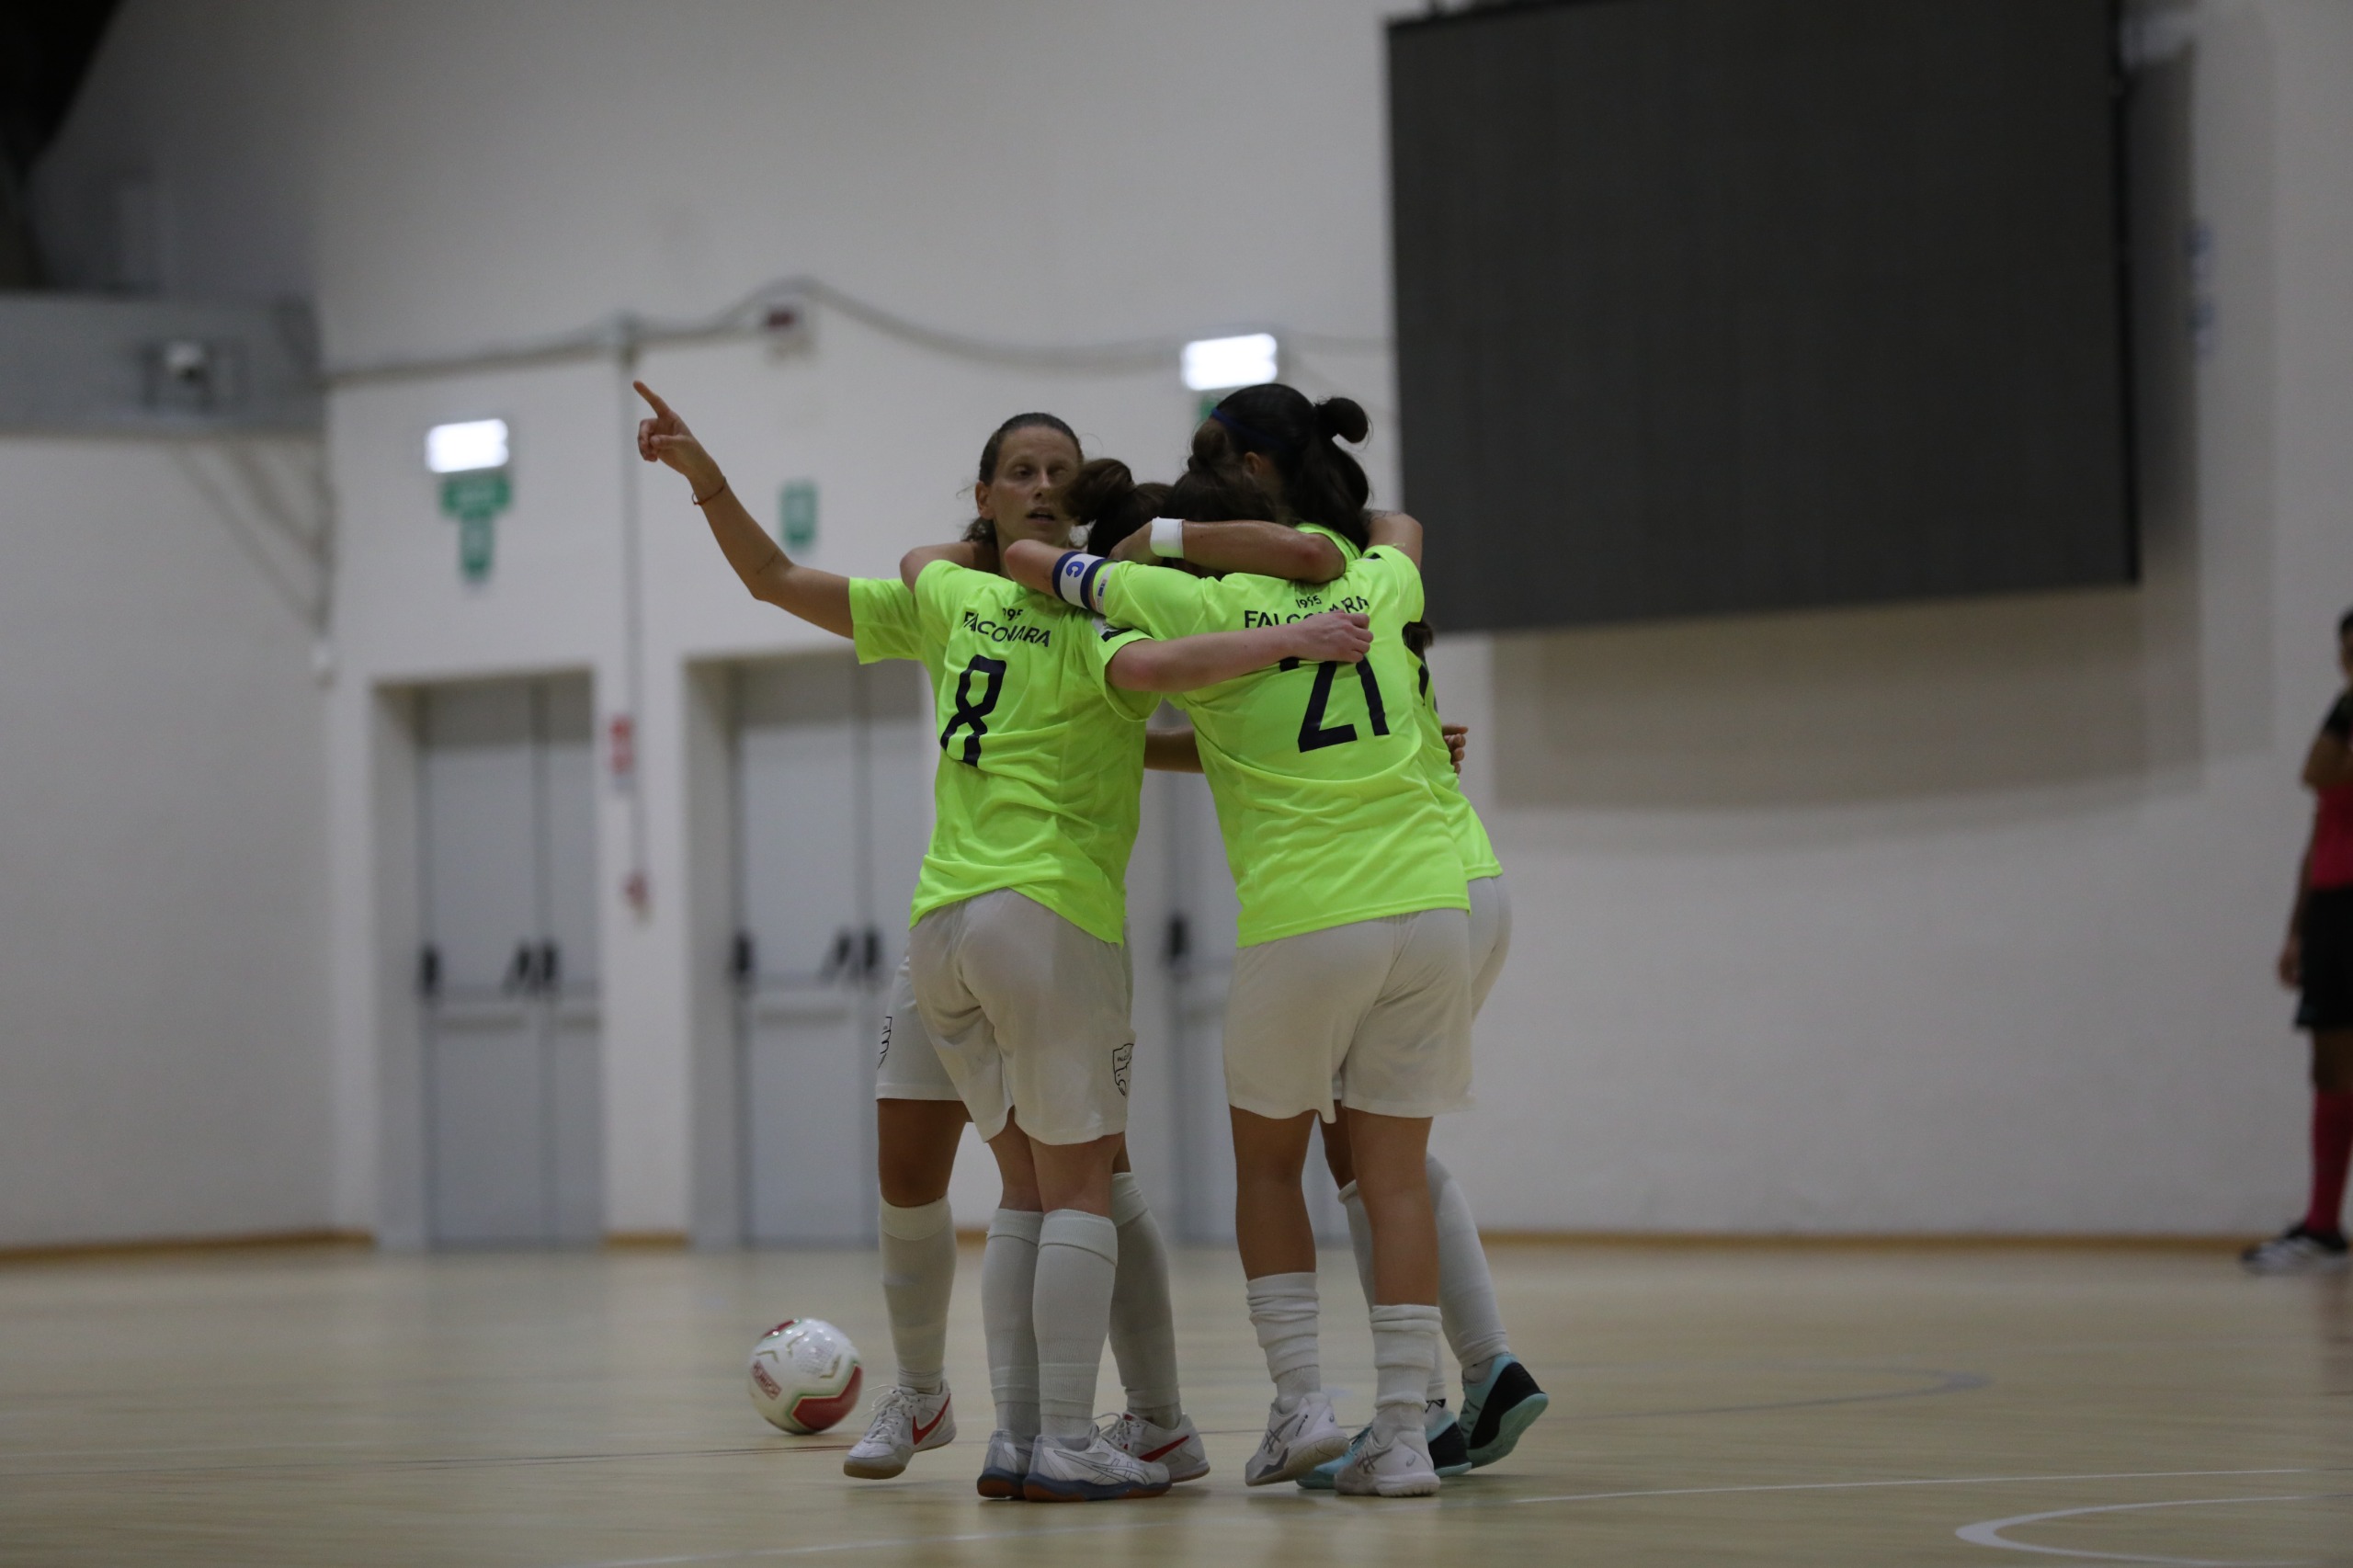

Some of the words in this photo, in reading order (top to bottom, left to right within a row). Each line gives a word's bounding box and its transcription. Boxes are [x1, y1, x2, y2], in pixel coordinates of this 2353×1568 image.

[1066, 561, 1085, 578] C
[940, 653, 1007, 767] 8
[1279, 653, 1391, 754] 21
